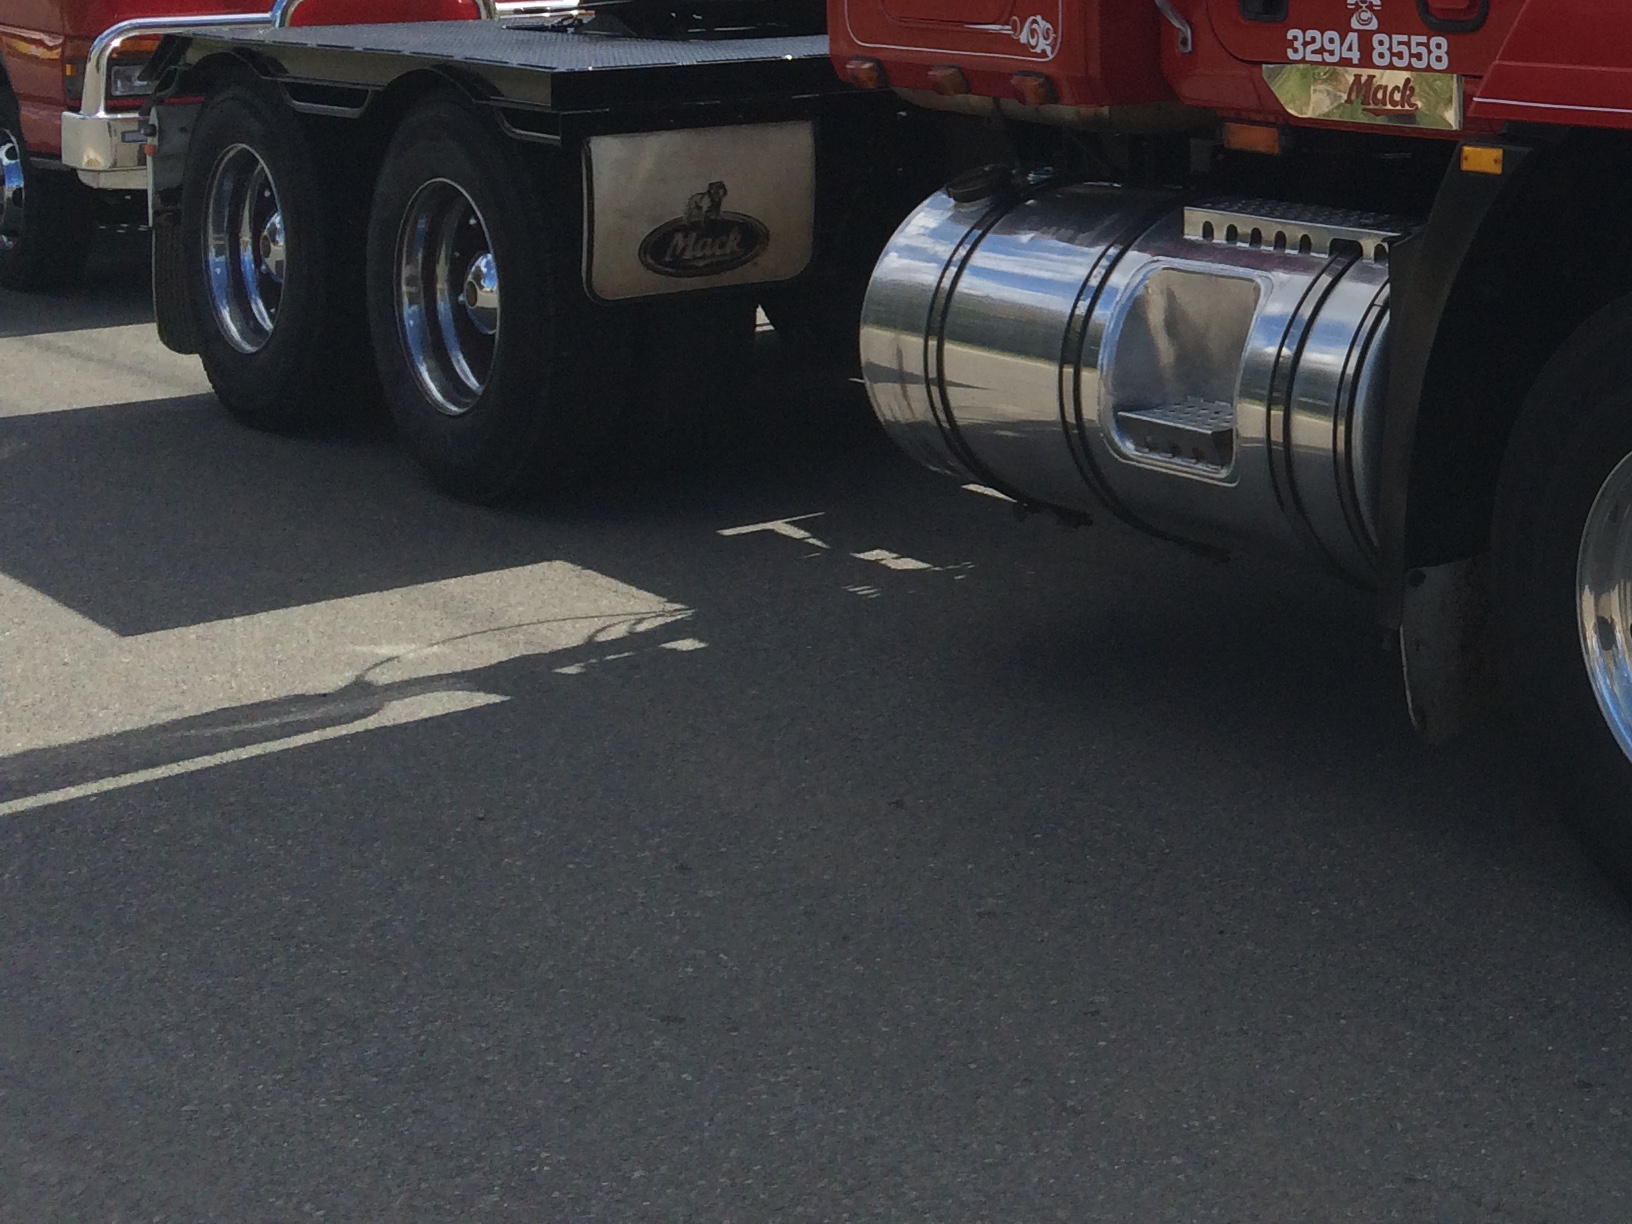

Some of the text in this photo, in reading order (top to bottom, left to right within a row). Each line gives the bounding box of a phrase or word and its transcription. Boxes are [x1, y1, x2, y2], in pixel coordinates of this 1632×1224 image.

[1286, 28, 1448, 70] 3294 8558
[1344, 73, 1419, 114] Mack
[664, 228, 743, 261] Mack
